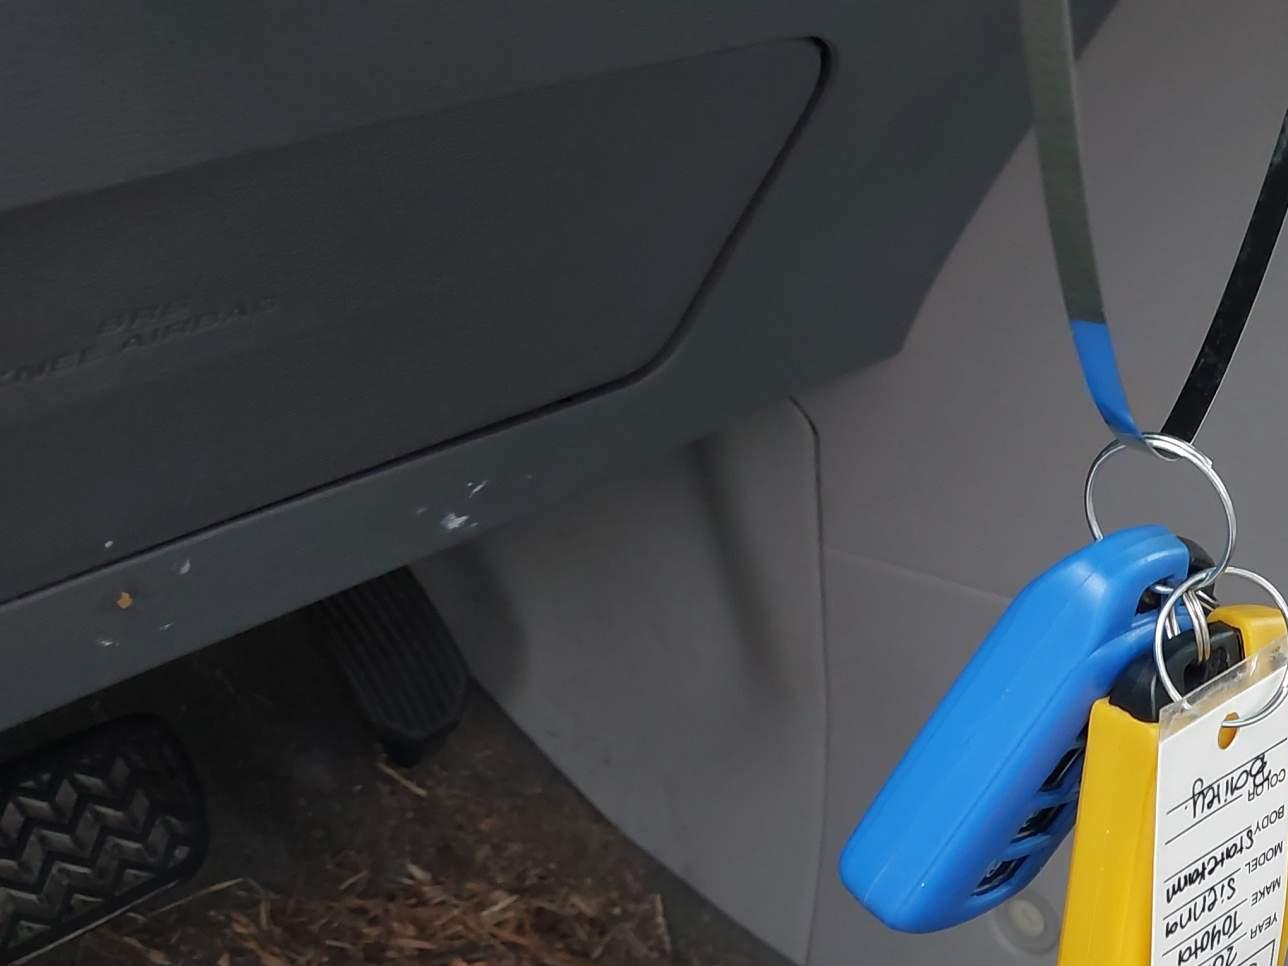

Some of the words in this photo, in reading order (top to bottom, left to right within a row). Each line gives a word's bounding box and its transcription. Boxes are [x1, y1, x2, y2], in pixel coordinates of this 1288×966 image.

[1247, 768, 1287, 802] COLOR
[1253, 805, 1285, 835] BODY
[1245, 841, 1284, 874] MODEL
[1251, 875, 1282, 907] MAKE
[1250, 912, 1278, 940] YEAR
